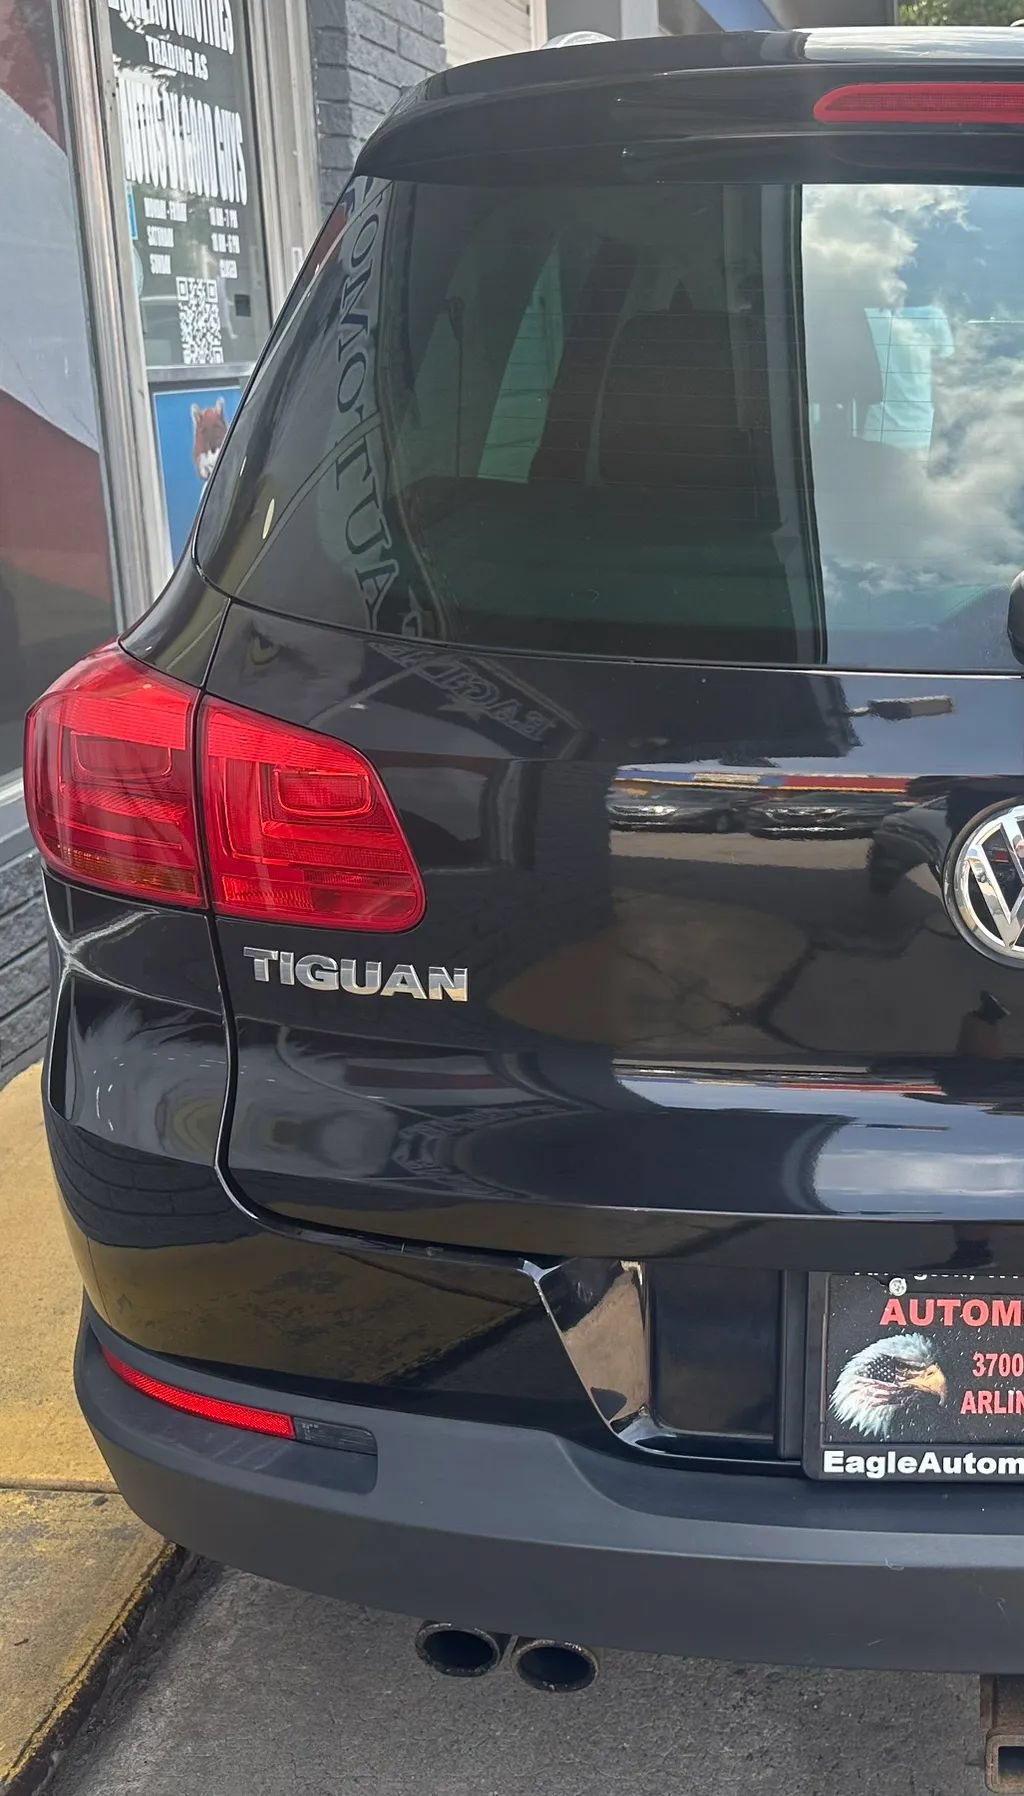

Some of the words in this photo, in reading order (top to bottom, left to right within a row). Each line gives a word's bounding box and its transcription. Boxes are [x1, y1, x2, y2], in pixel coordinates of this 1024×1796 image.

[146, 35, 193, 76] TRADING
[194, 52, 208, 80] AS
[213, 105, 248, 206] GUYS
[243, 946, 468, 1002] TIGUAN
[972, 1353, 1024, 1378] 3700
